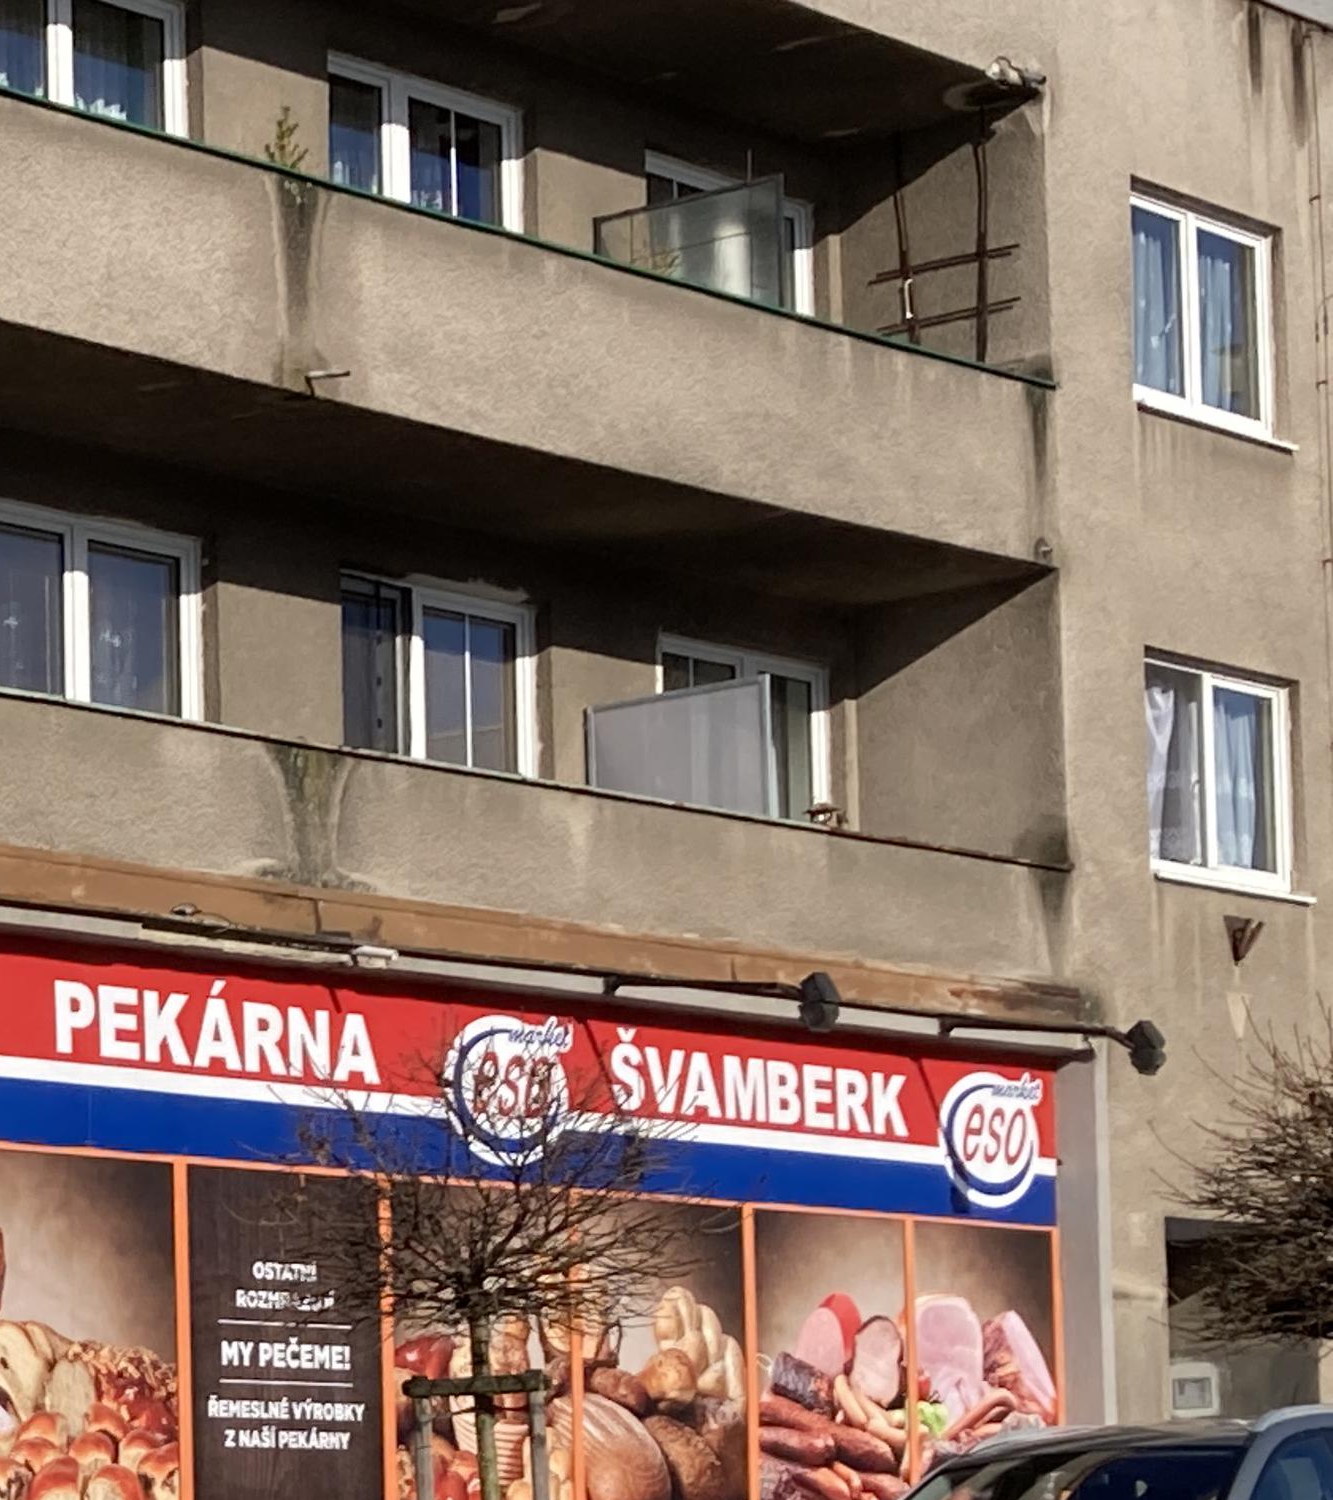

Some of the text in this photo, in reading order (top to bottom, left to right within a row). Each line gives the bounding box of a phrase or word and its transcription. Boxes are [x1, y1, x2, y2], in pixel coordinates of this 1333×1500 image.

[53, 980, 381, 1085] PEKÁRNA
[474, 1051, 551, 1117] eso
[610, 1027, 909, 1137] ŠVAMBERK
[963, 1103, 1026, 1165] eso
[221, 1336, 351, 1371] MY PEČEME!
[207, 1394, 365, 1422] ŘEMESLNÉ VÝROBKY
[224, 1425, 351, 1449] Z NAŠÍ PEKÁRNY
